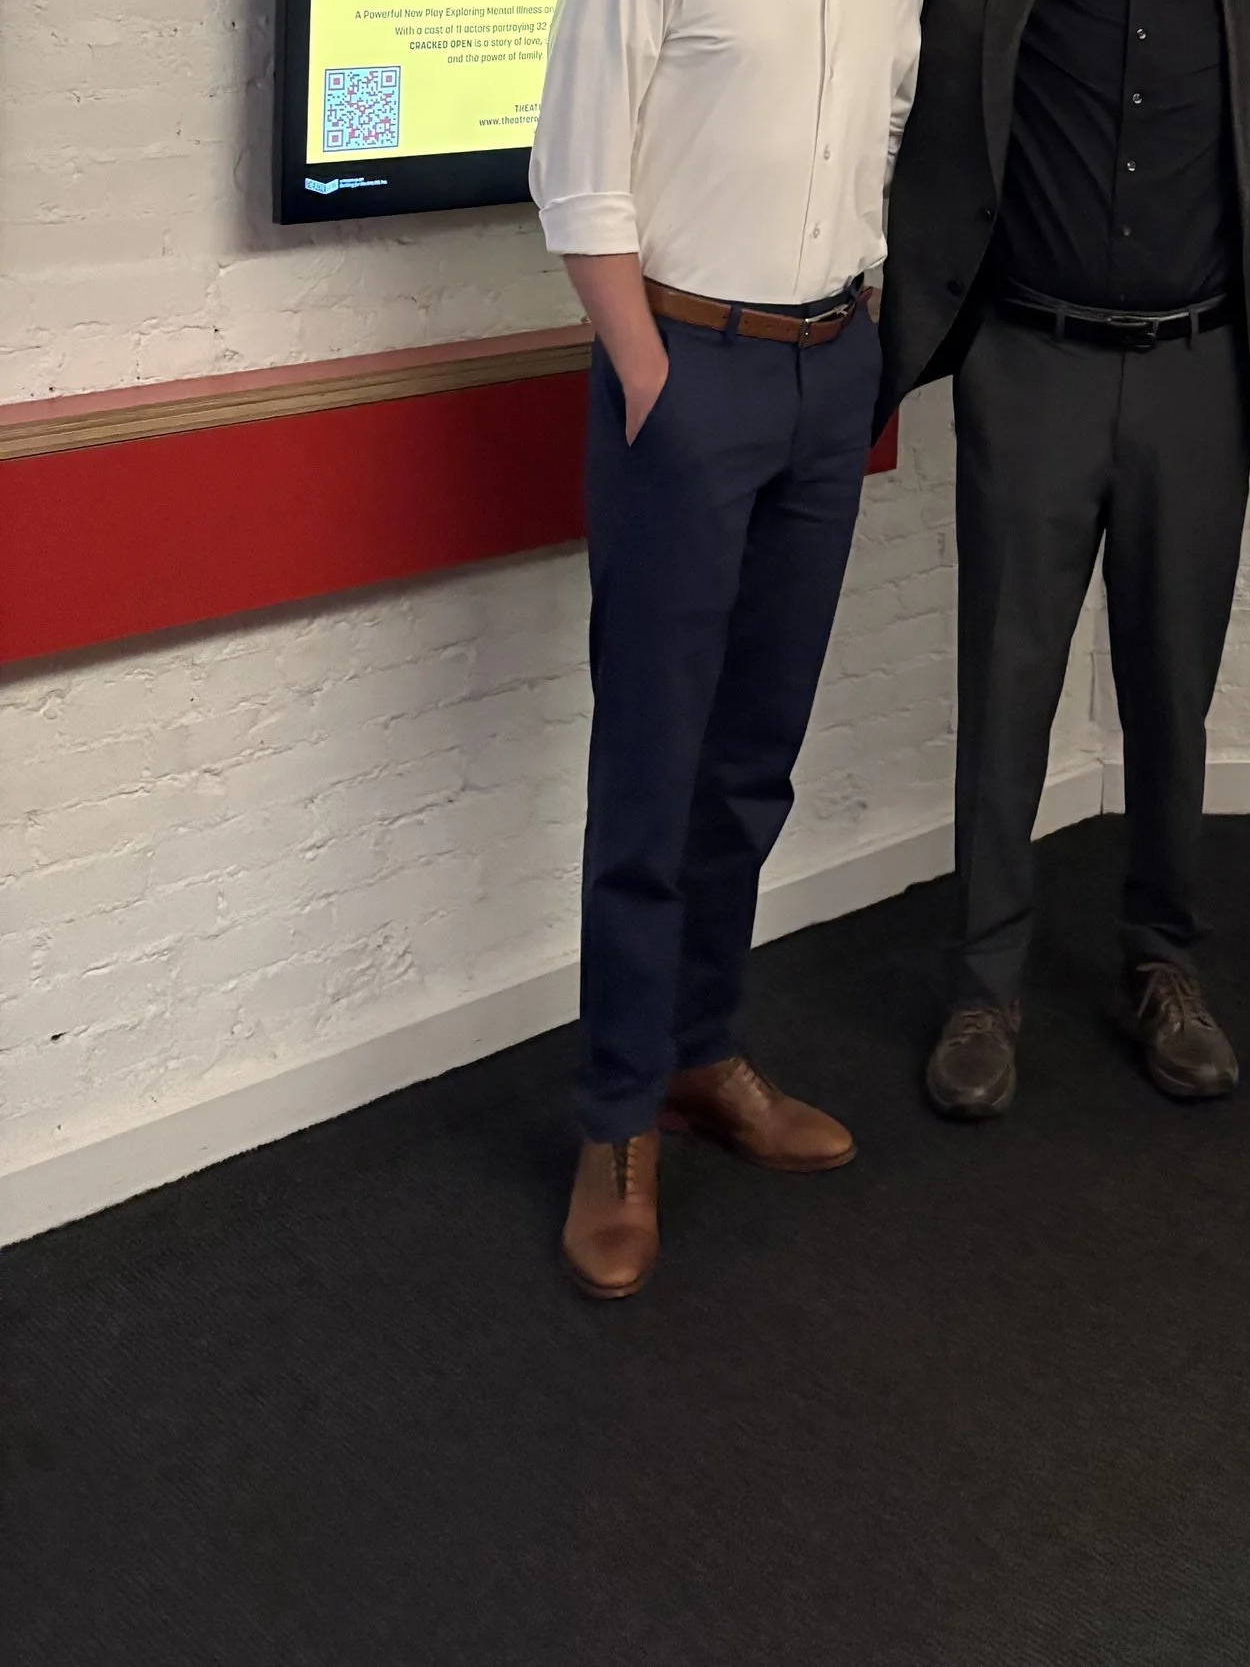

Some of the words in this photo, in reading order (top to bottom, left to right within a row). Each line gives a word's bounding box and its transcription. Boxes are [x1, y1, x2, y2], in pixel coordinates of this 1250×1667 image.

[355, 10, 361, 19] A
[363, 9, 402, 19] Powerful
[404, 9, 423, 18] New
[425, 8, 443, 18] Play
[446, 7, 485, 17] Exploring
[487, 6, 515, 15] Mental
[516, 6, 542, 14] Illness
[544, 6, 555, 14] an
[395, 26, 414, 35] With
[416, 27, 422, 35] a
[424, 26, 443, 35] cast
[445, 25, 453, 34] of
[464, 25, 490, 33] actors
[492, 23, 534, 34] portraying
[536, 22, 547, 31] 32
[409, 40, 448, 50] CRACKED
[450, 39, 472, 49] OPEN
[474, 39, 481, 47] is
[483, 39, 489, 47] a
[491, 39, 512, 47] story
[514, 37, 521, 46] of
[524, 37, 543, 46] love,
[448, 54, 463, 63] and
[465, 54, 479, 63] the
[481, 53, 506, 64] power
[508, 52, 516, 61] of
